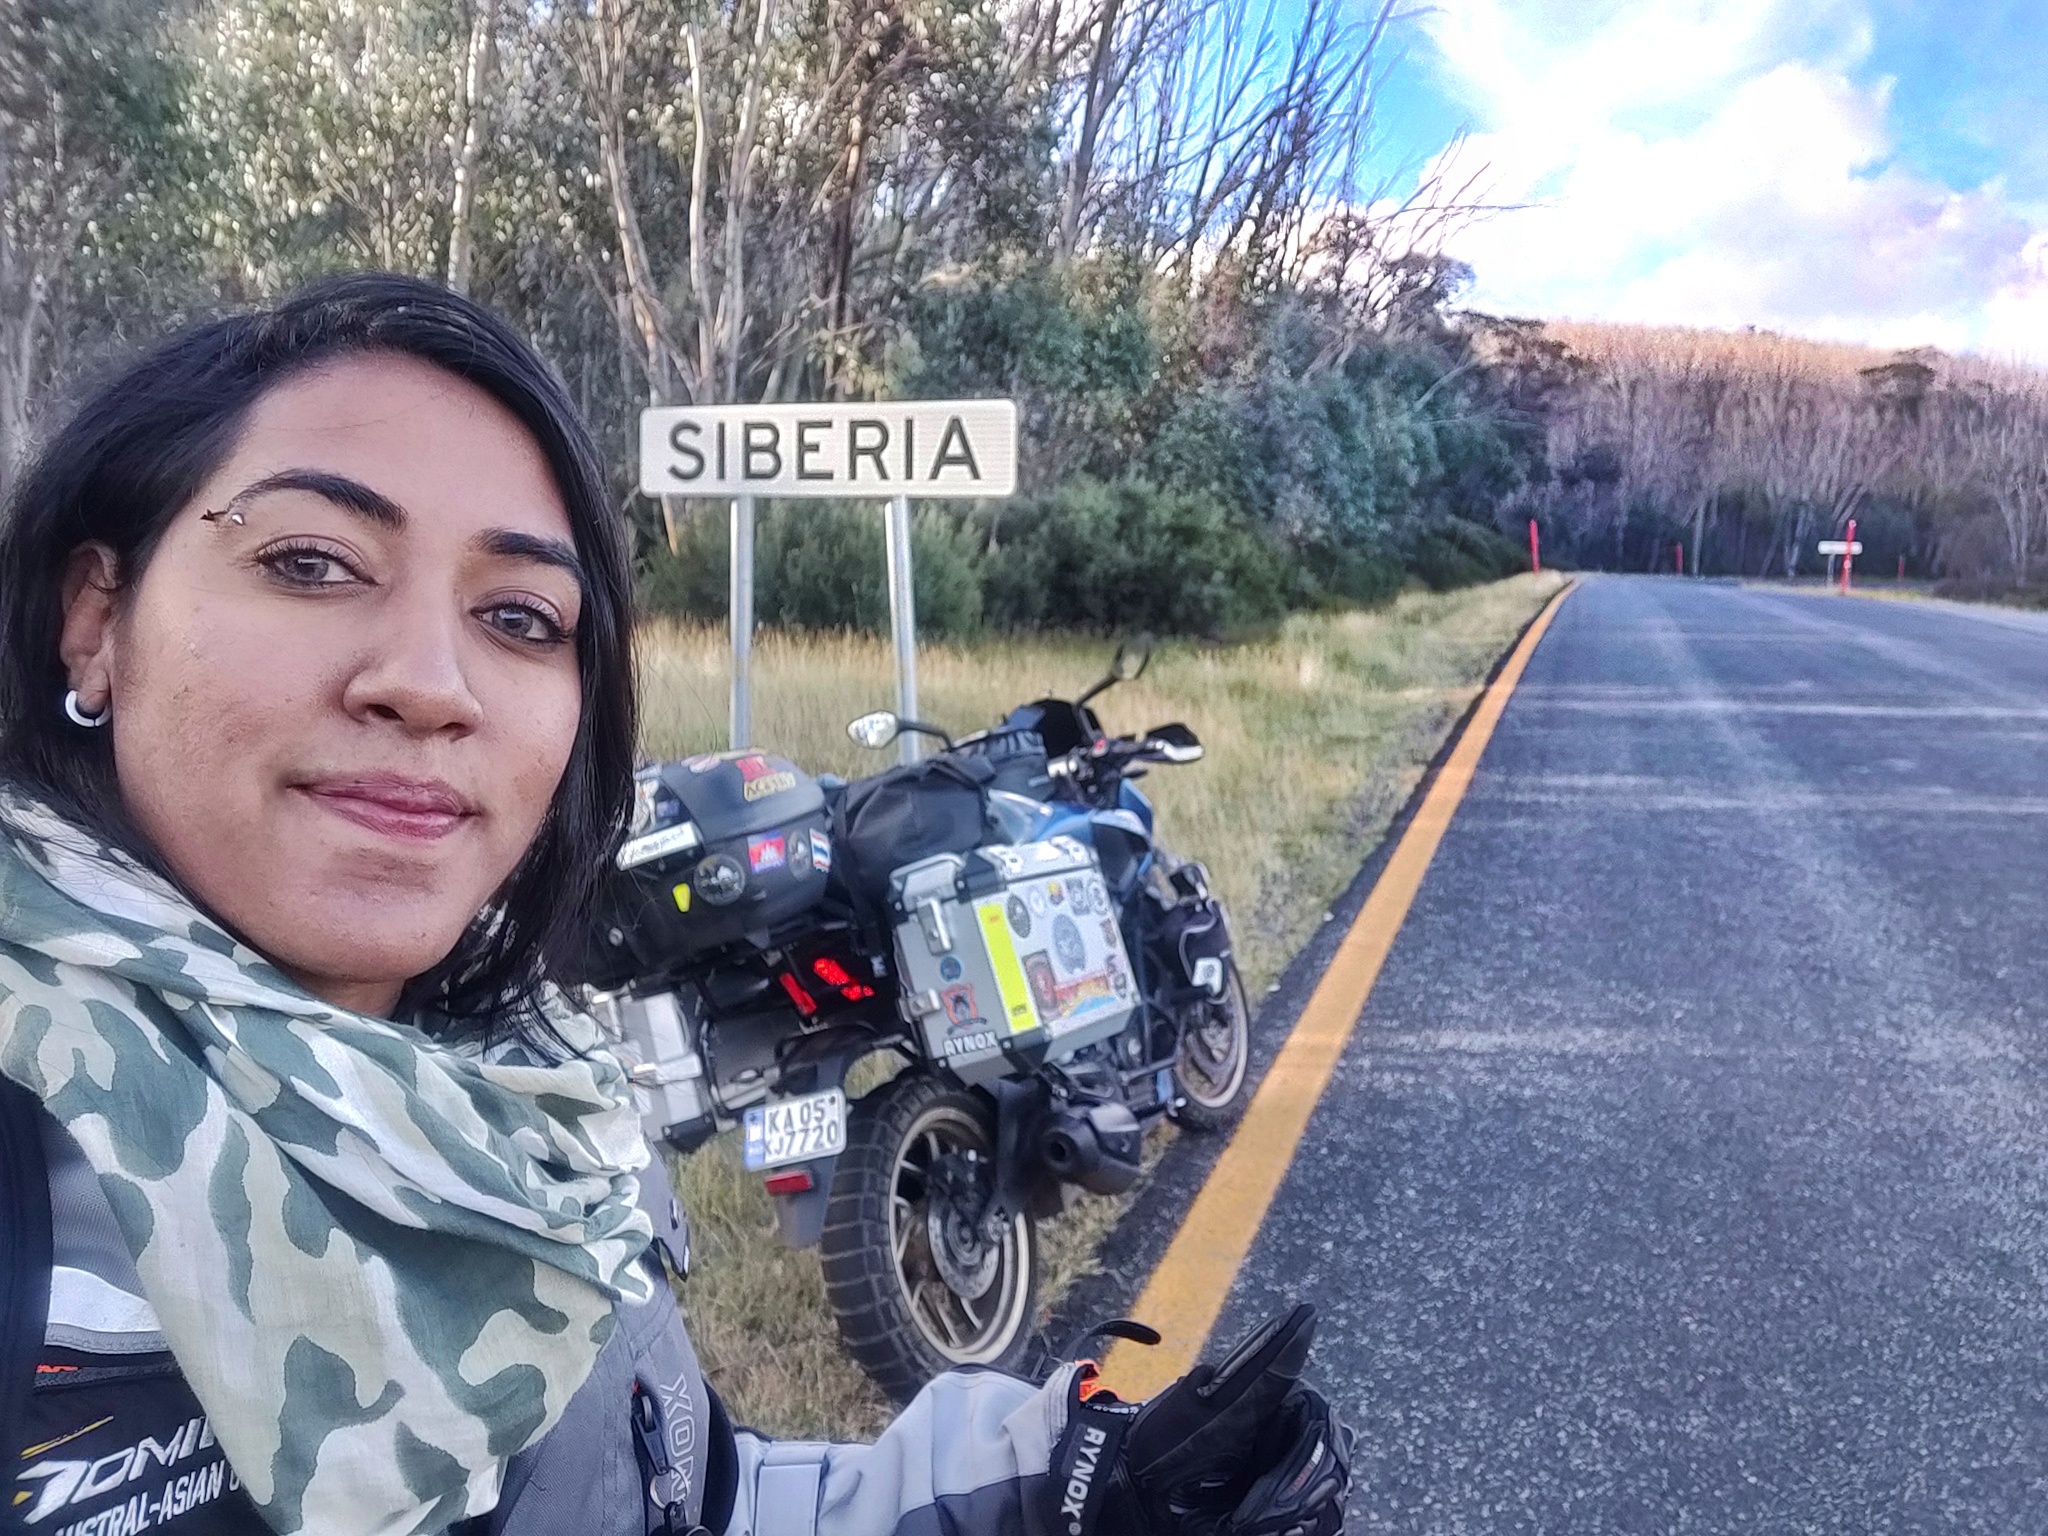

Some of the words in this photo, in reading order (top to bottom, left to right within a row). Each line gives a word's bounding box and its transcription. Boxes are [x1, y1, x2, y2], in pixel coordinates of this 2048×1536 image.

[667, 415, 982, 481] SIBERIA
[55, 1459, 226, 1536] STRAL-ASIAN
[1061, 1427, 1107, 1520] RYNOX
